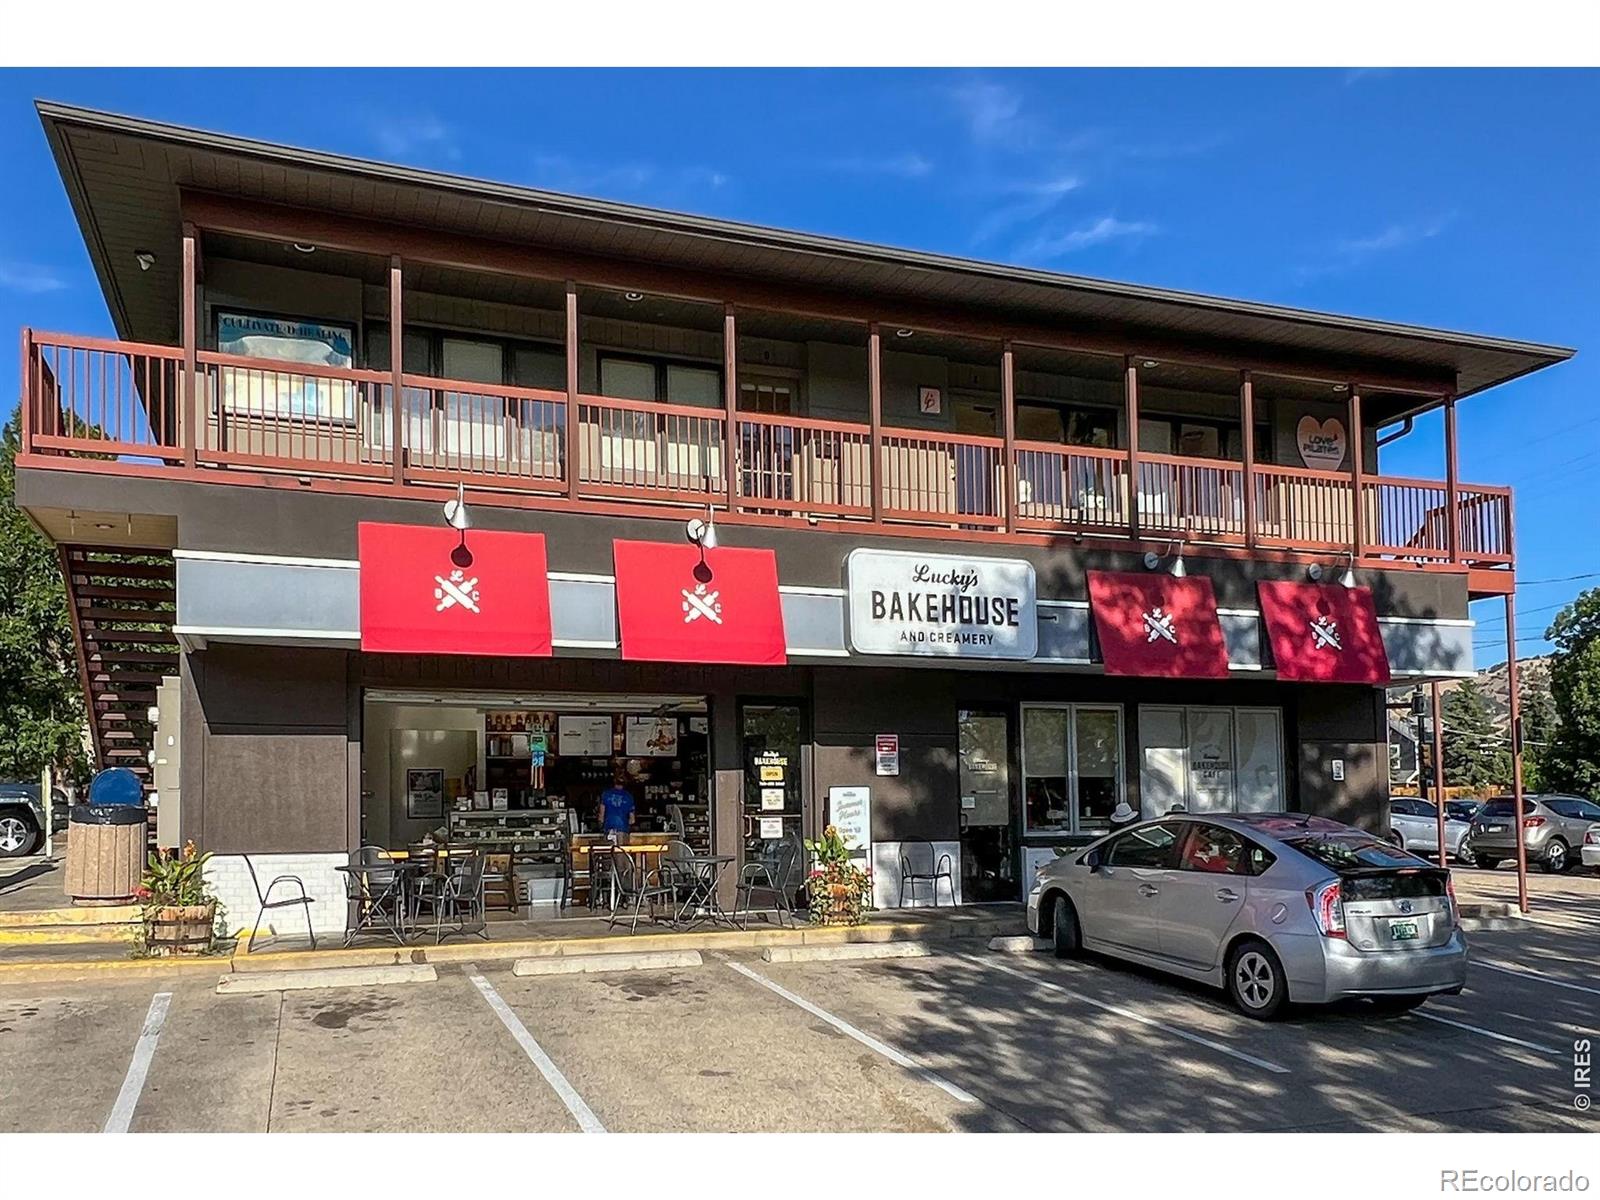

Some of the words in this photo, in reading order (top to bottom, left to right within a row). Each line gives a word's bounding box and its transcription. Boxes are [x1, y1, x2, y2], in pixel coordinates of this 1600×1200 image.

[912, 563, 979, 593] Lucky's
[871, 590, 1019, 627] BAKEHOUSE
[900, 631, 925, 642] AND
[929, 631, 994, 645] CREAMERY
